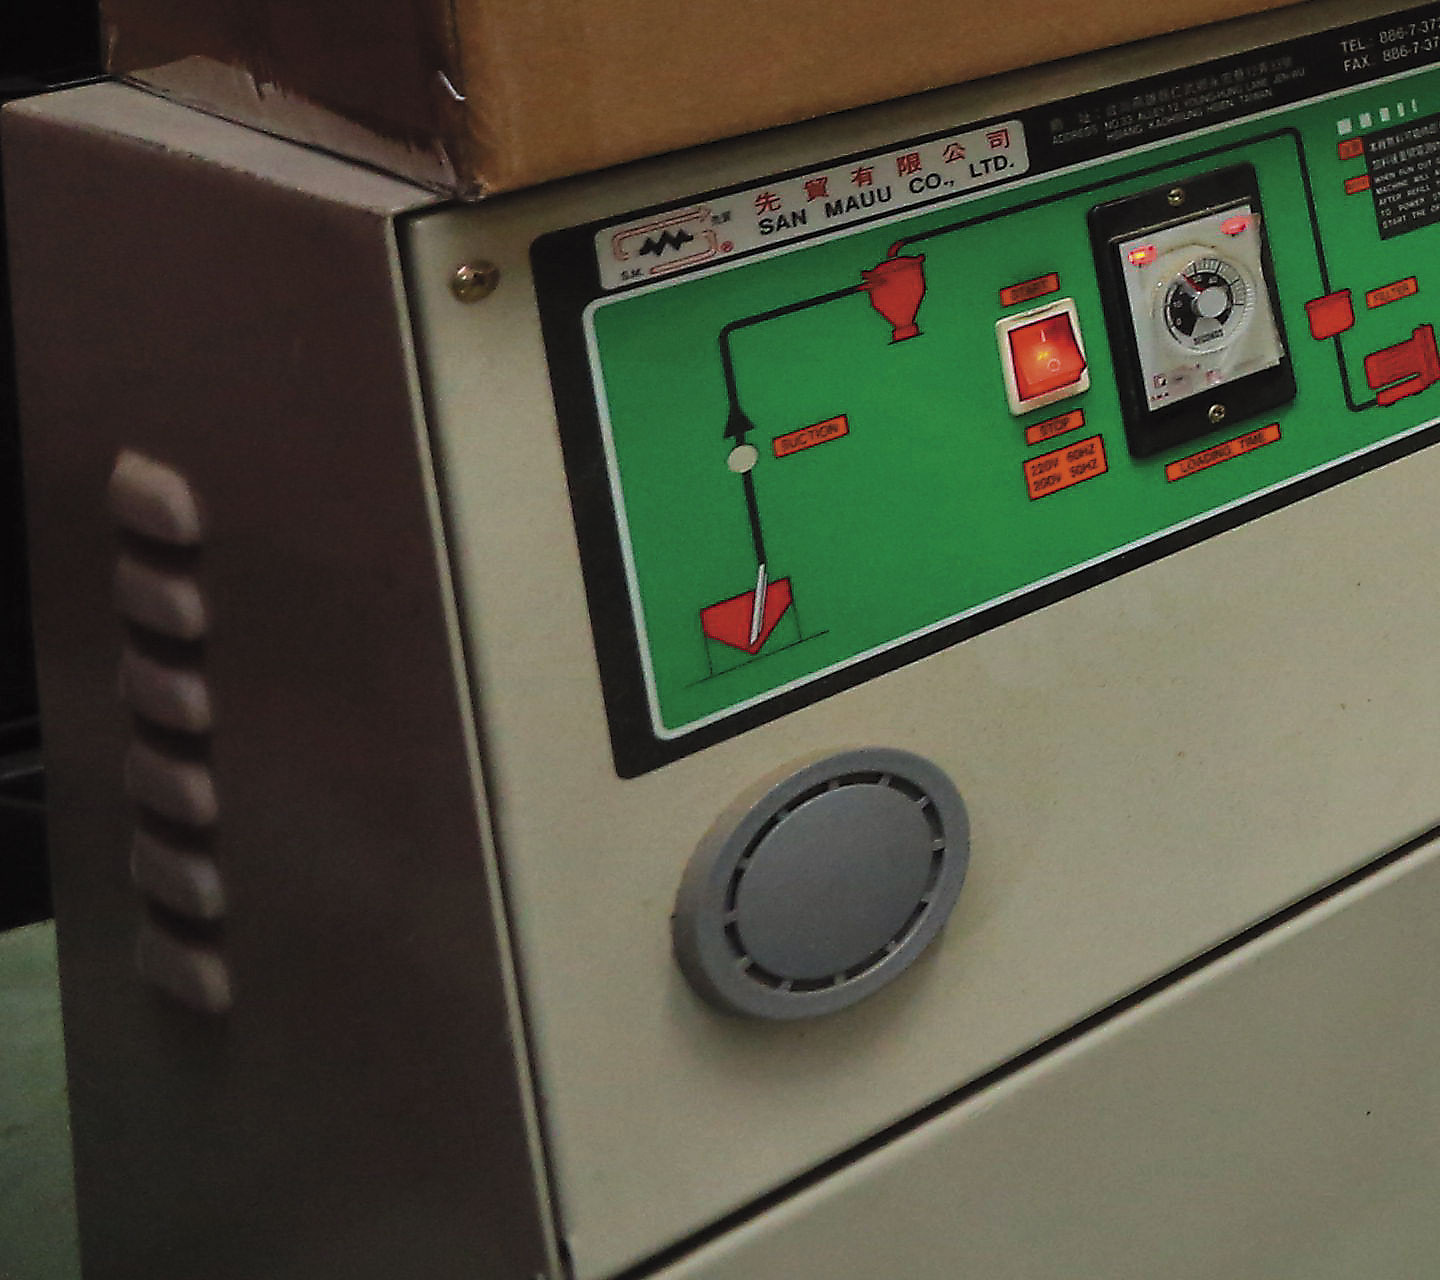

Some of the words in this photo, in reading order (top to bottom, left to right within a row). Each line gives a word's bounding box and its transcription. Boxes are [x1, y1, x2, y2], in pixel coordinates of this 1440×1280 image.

[754, 128, 1011, 216] 先貿有限公司
[758, 209, 807, 237] SAN
[825, 186, 892, 218] MAUU
[969, 155, 1015, 179] LTD.
